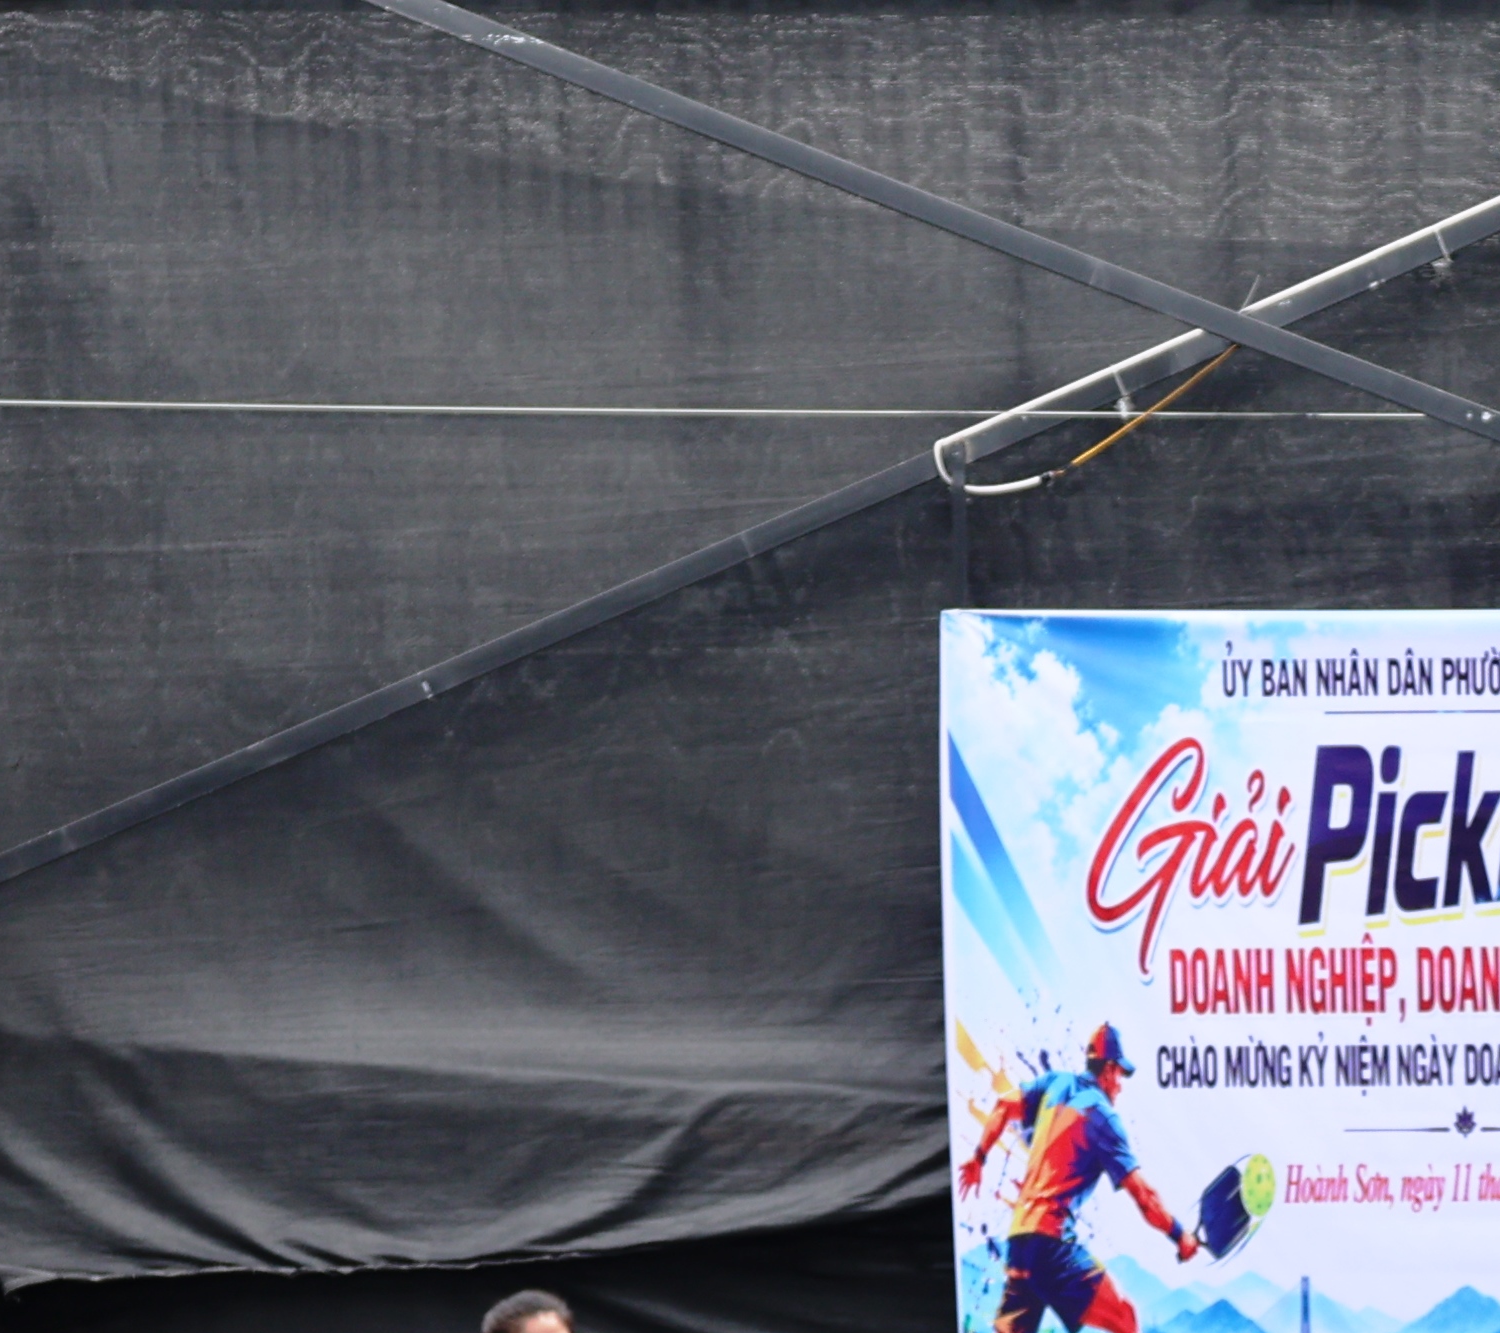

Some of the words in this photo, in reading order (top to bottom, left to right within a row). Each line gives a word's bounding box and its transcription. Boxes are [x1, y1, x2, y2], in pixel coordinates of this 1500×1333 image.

[1222, 640, 1253, 697] ỦY
[1261, 658, 1307, 697] BAN
[1315, 648, 1378, 697] NHÂN
[1388, 647, 1433, 696] DÂN
[1086, 737, 1296, 975] Giải
[1169, 947, 1275, 1014] DOANH
[1286, 932, 1406, 1026] NGHIỆP,
[1156, 1035, 1218, 1089] CHÀO
[1225, 1035, 1292, 1088] MỪNG
[1299, 1031, 1328, 1087] KỶ
[1335, 1034, 1390, 1096] NIỆM
[1397, 1034, 1457, 1087] NGÀY
[1284, 1163, 1348, 1204] Hoành
[1353, 1162, 1394, 1209] Sơn,
[1400, 1163, 1446, 1213] ngày
[1451, 1162, 1472, 1202] 11
